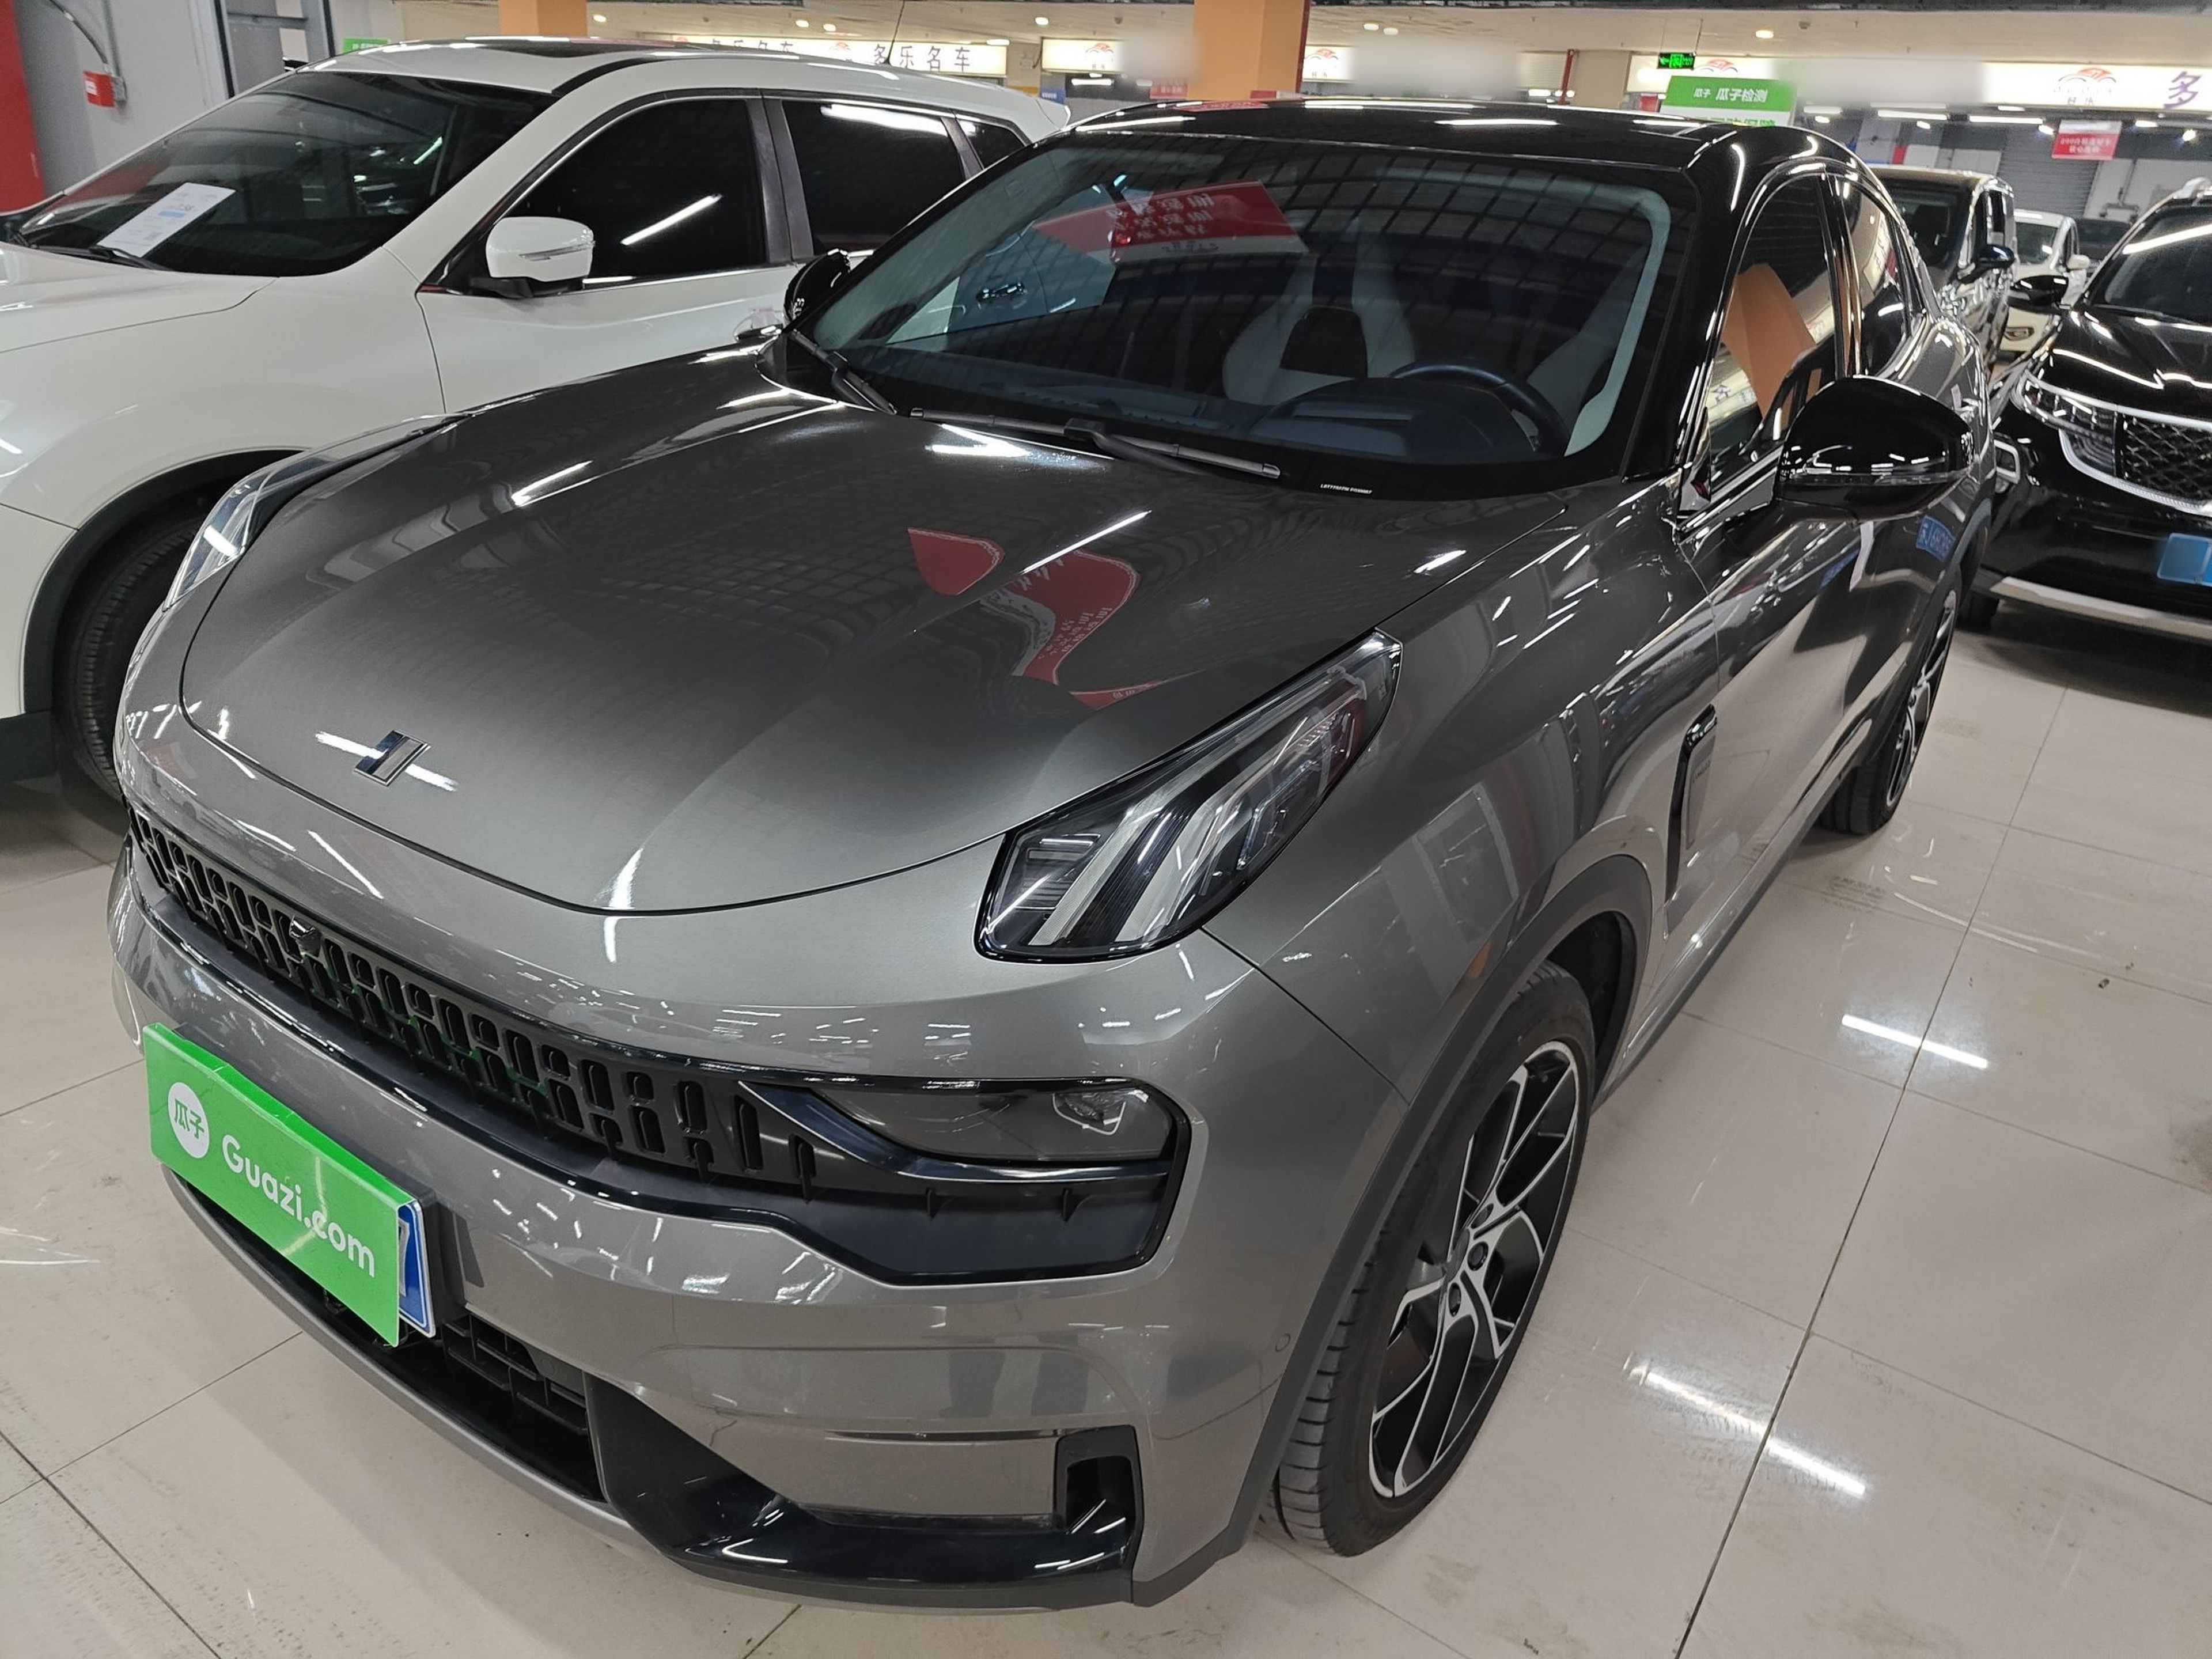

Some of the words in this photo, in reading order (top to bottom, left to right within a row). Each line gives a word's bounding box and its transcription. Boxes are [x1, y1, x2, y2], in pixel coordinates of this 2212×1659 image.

[874, 44, 970, 73] 多乐名车
[1694, 88, 1711, 98] 瓜子
[1715, 87, 1768, 103] 瓜子检测
[2164, 71, 2201, 108] 多
[173, 1098, 205, 1139] 瓜子
[222, 1134, 376, 1278] Guazi.com
